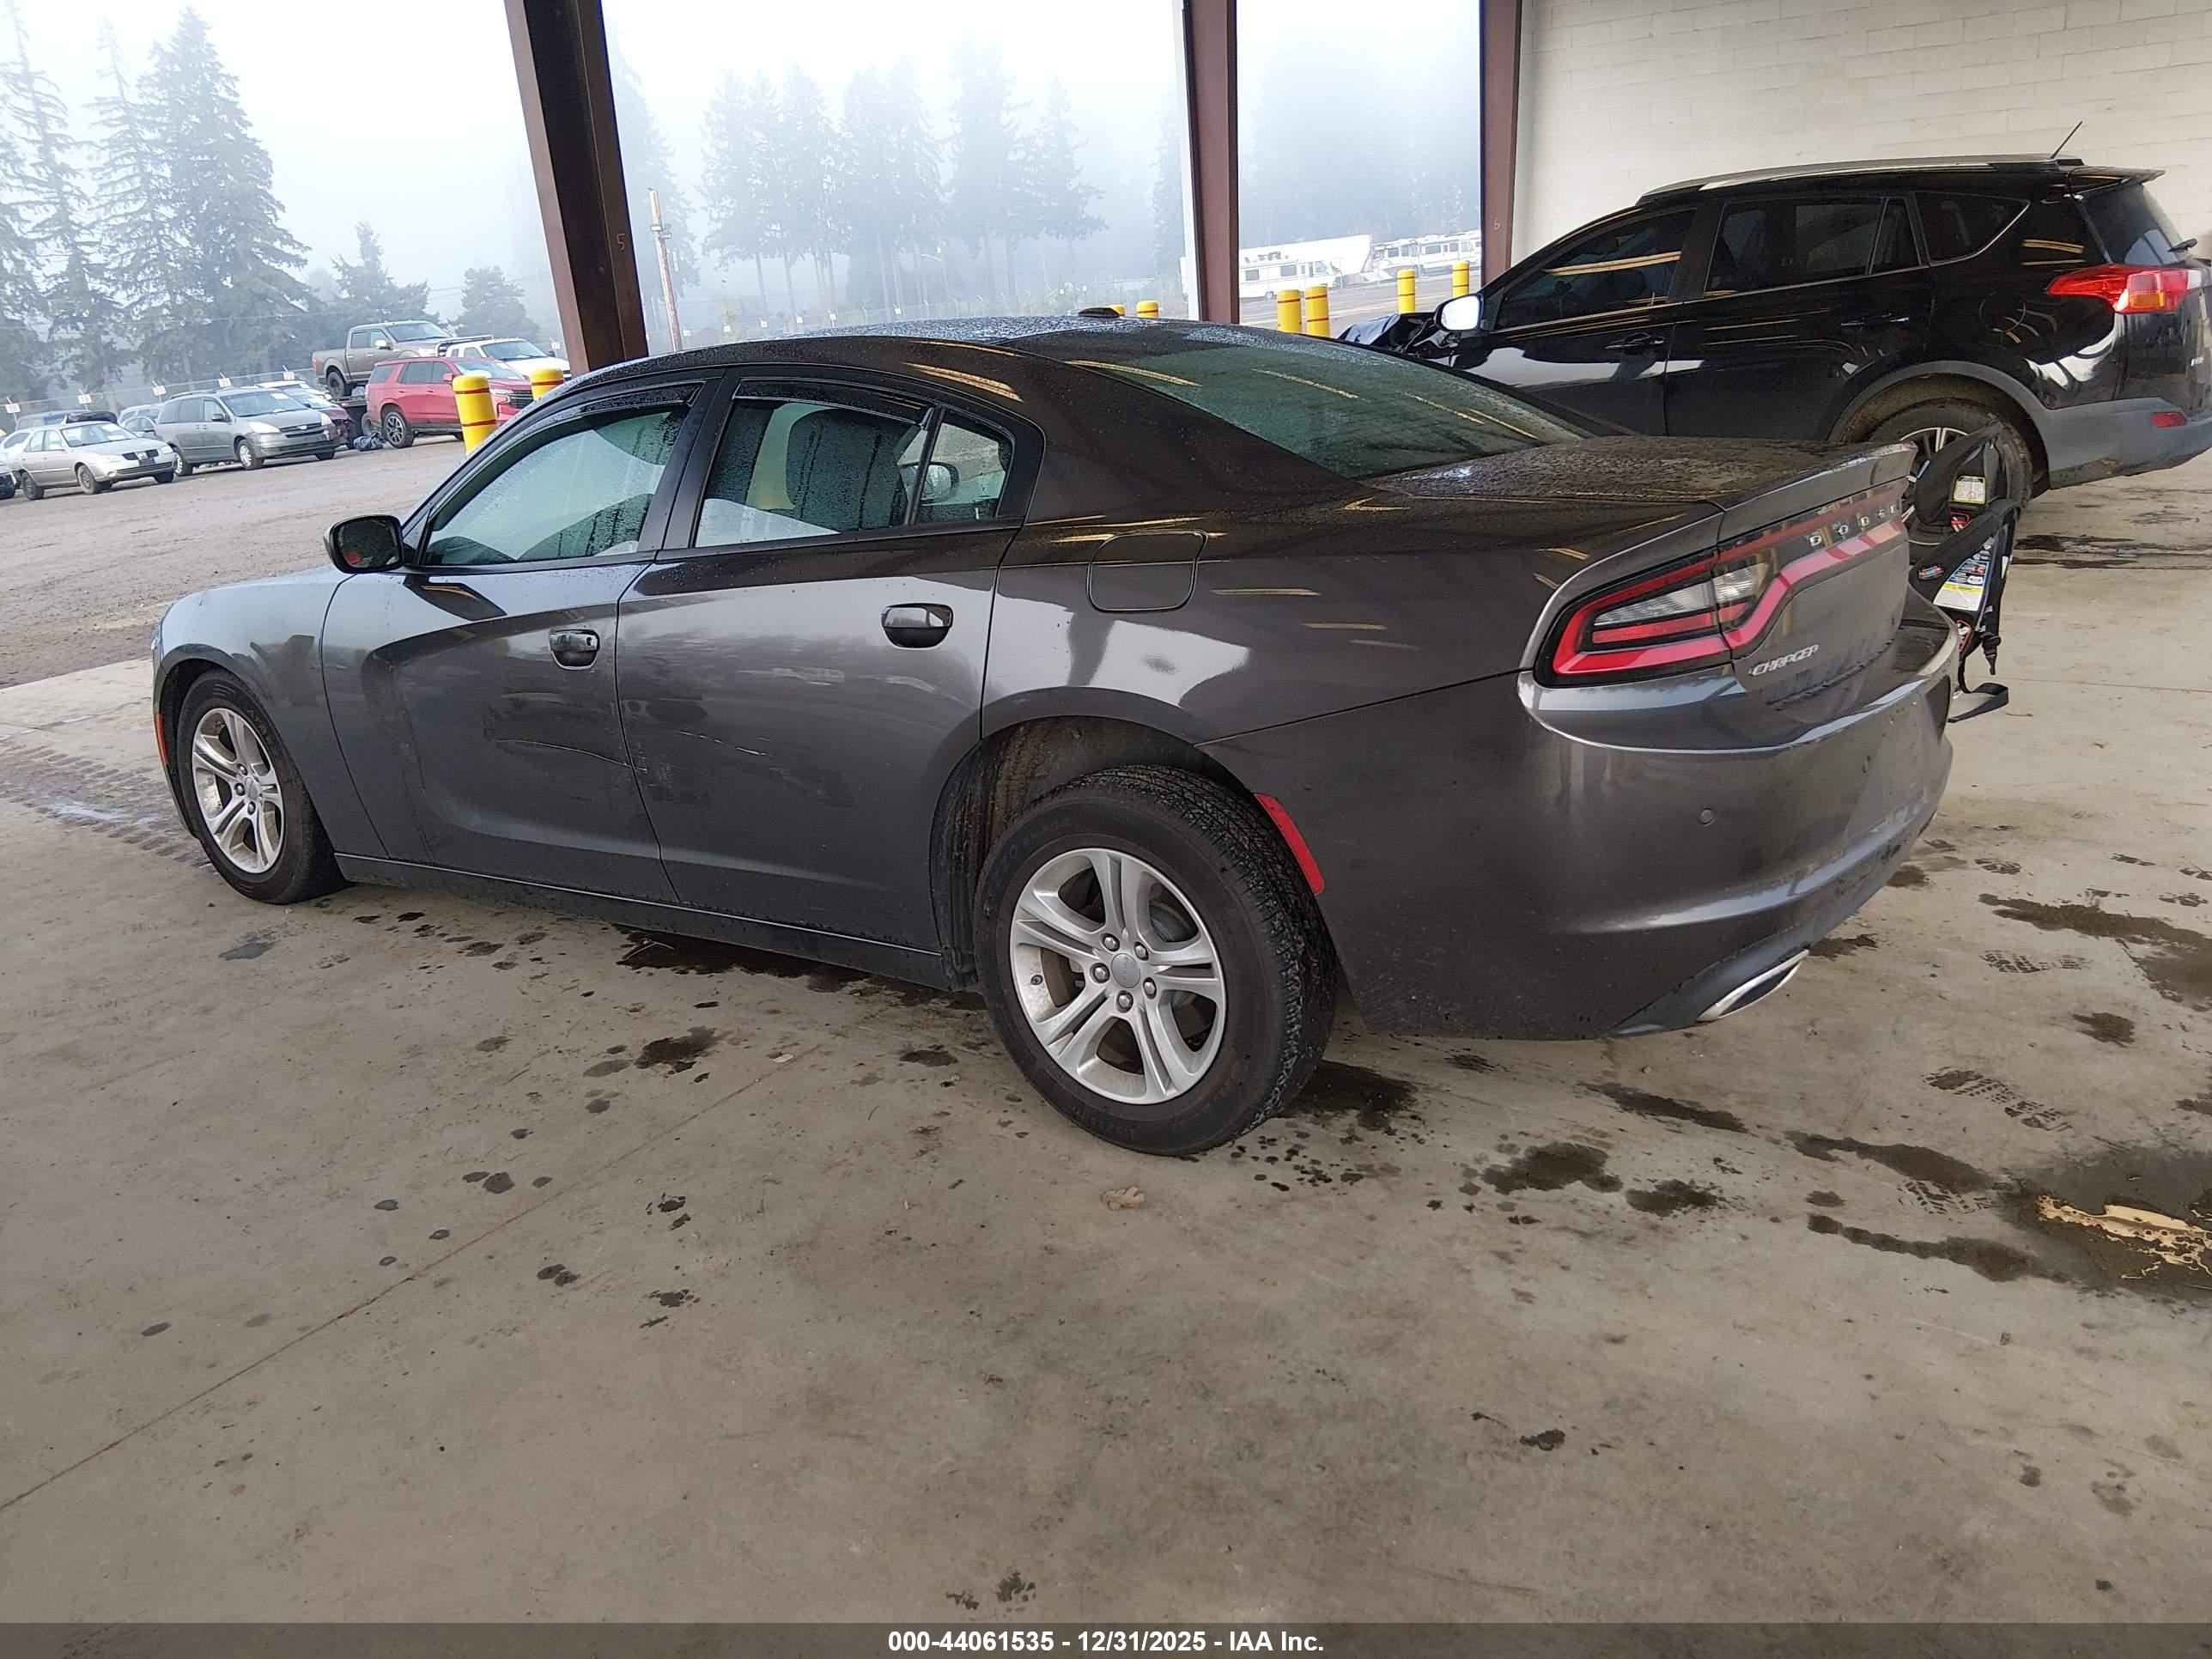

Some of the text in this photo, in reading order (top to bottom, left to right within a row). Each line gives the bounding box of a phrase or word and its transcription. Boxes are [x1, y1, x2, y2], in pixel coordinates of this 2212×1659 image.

[1493, 217, 1501, 231] 6
[617, 233, 626, 251] 5
[1751, 644, 1820, 677] CHARGER
